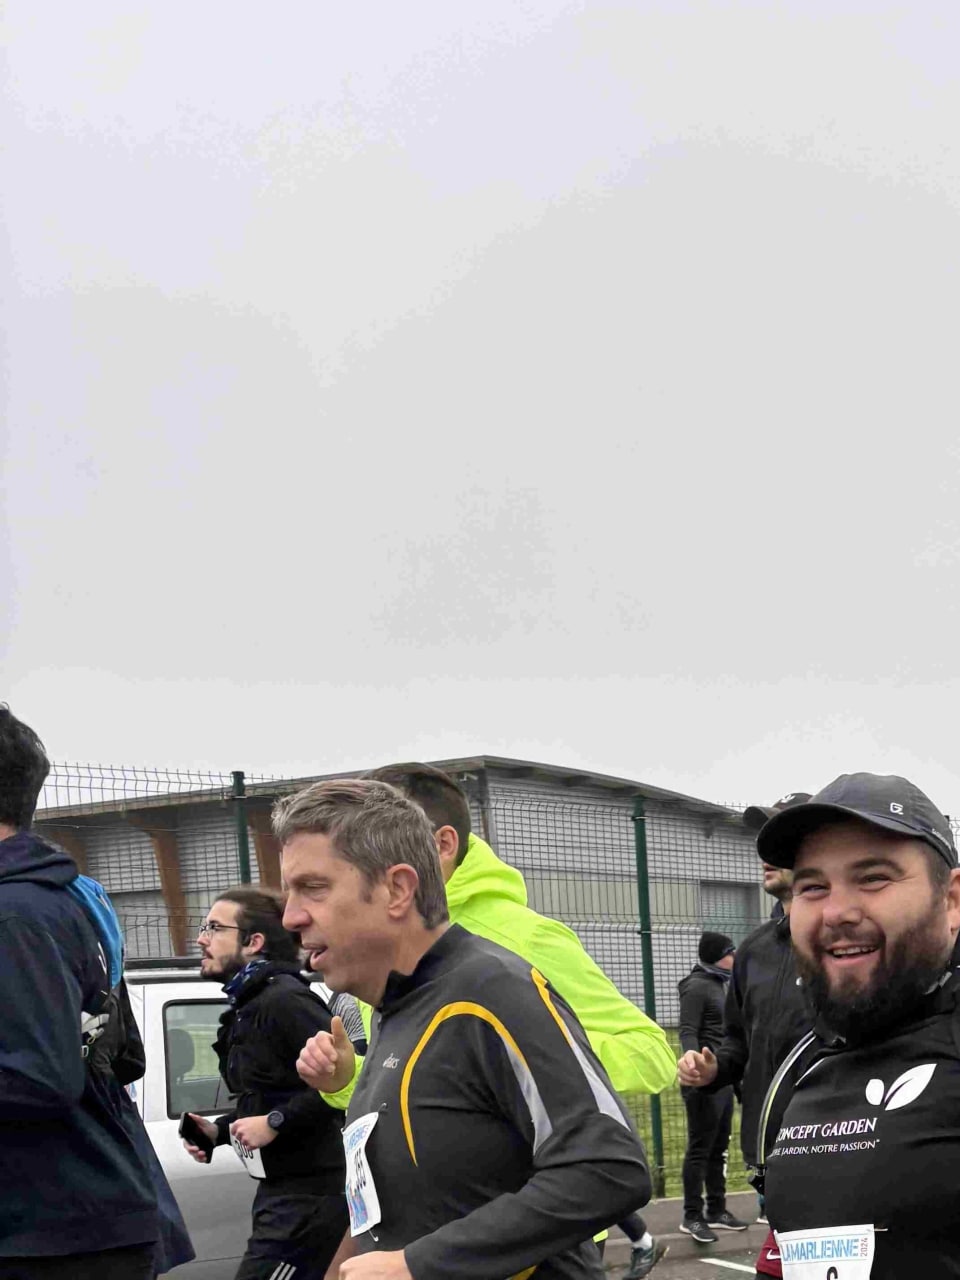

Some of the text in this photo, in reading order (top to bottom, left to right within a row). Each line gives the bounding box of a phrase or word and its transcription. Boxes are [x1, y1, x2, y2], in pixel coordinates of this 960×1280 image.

[776, 1117, 878, 1142] ONCEPT GARDEN
[811, 1143, 838, 1154] NOTRE
[790, 1238, 860, 1261] MARLIENNE
[860, 1238, 869, 1257] 2024
